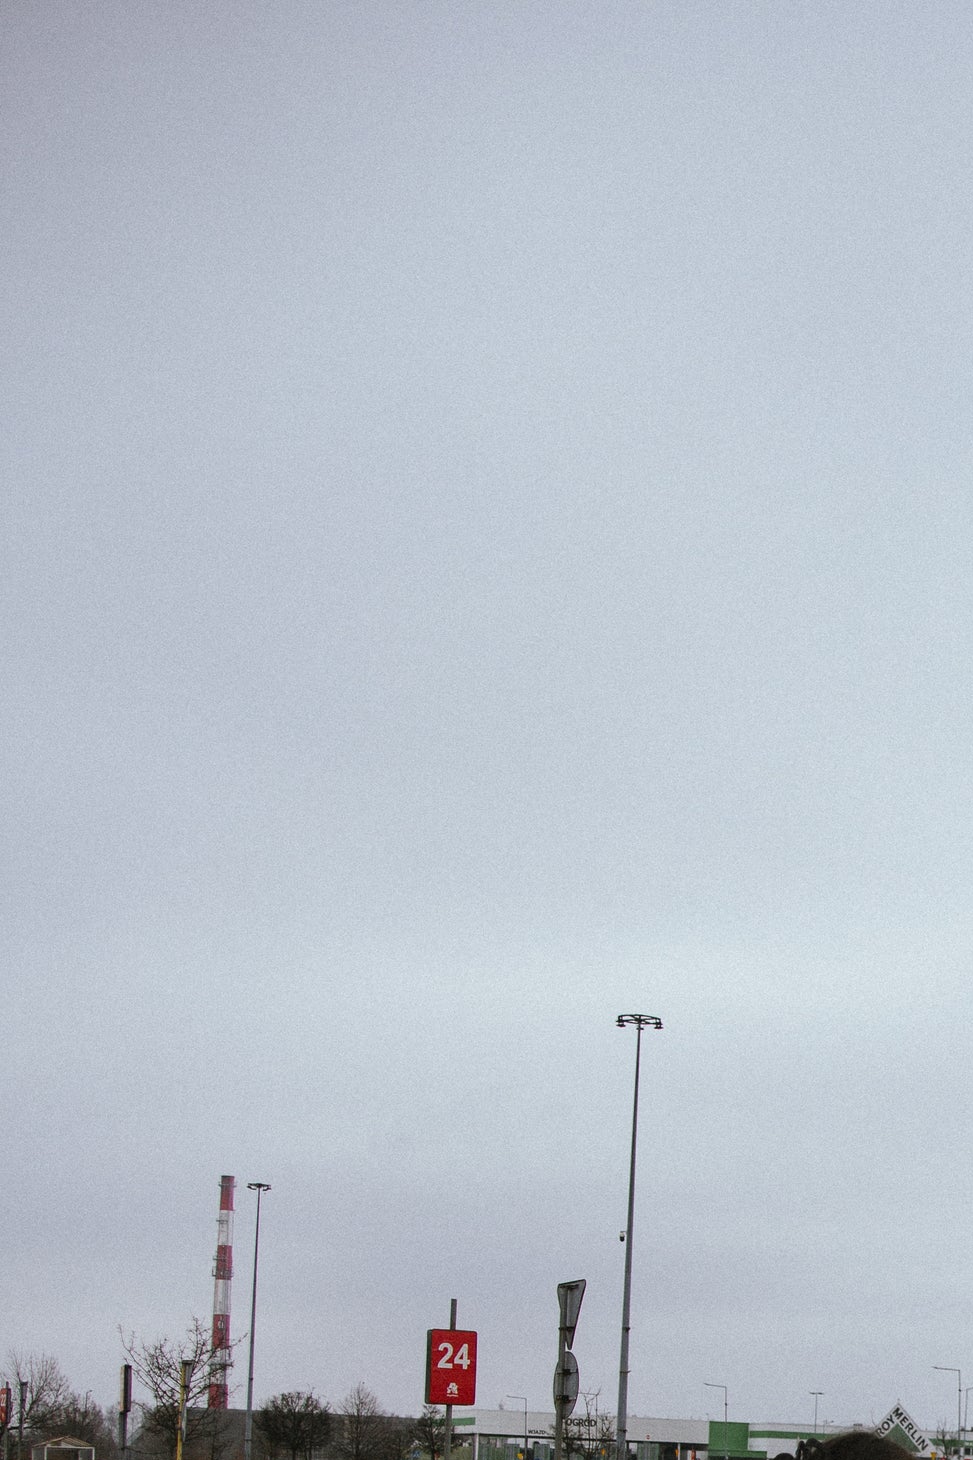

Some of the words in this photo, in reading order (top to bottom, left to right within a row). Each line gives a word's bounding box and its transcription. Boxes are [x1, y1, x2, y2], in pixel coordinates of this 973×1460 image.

[437, 1342, 471, 1370] 24
[875, 1414, 895, 1437] ROY
[892, 1407, 929, 1451] MERLIN
